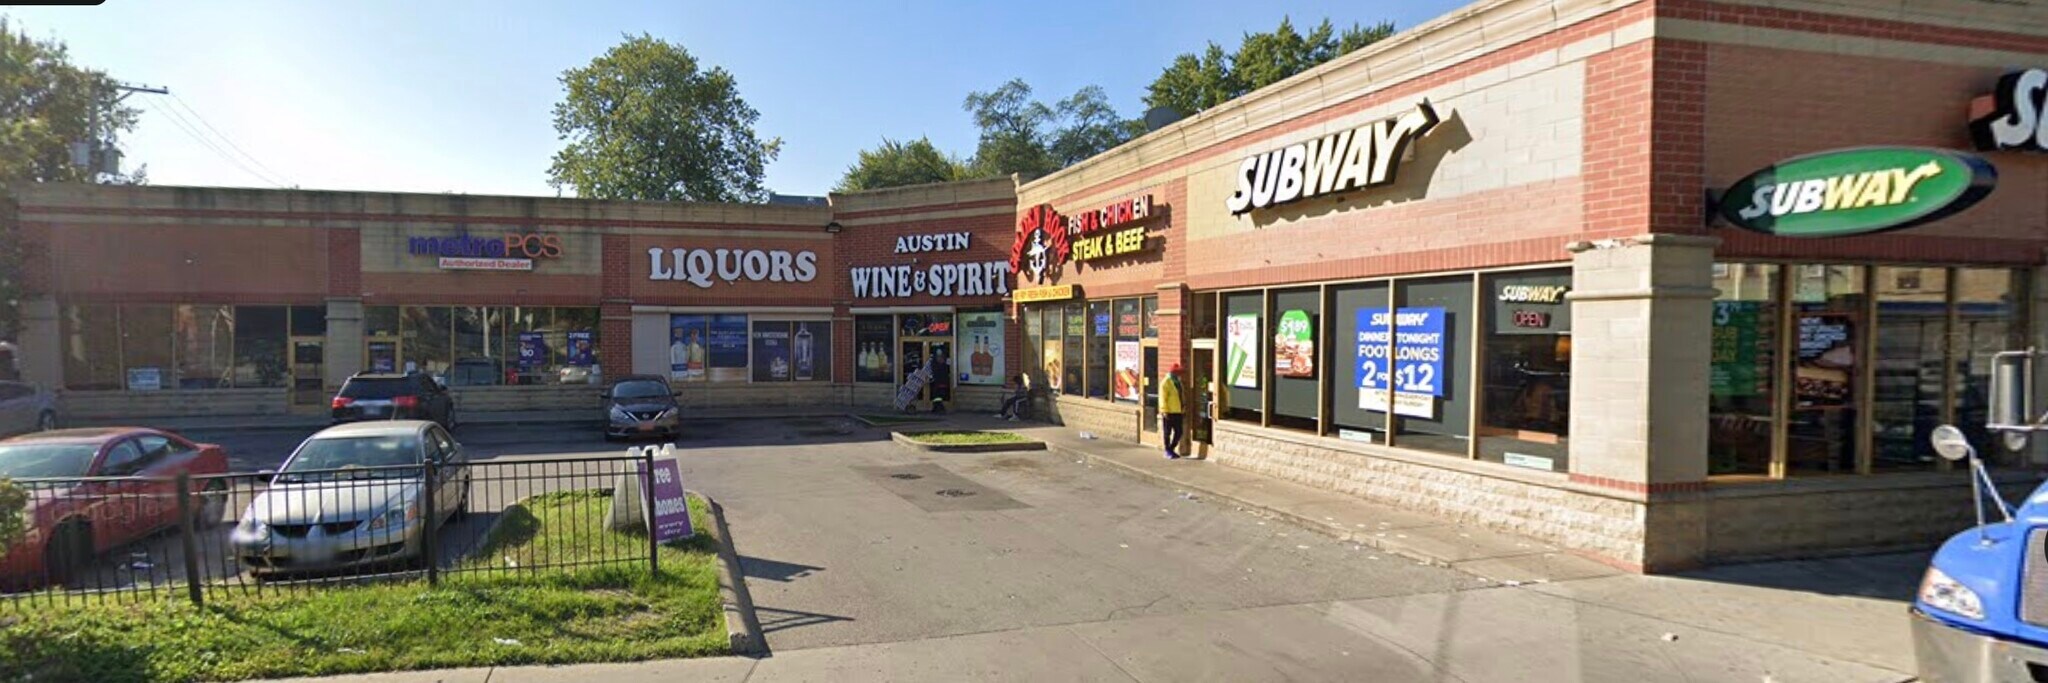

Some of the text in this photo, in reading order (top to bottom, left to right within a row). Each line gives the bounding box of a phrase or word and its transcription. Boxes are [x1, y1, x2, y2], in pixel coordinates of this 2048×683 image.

[1226, 104, 1434, 215] SUBWAY
[1739, 160, 1942, 221] SUBWAY
[1068, 195, 1149, 235] FISH & CHICKEN
[408, 232, 562, 258] metroPCS
[894, 232, 971, 254] AUSTIN
[1072, 227, 1145, 262] STEAK & BEEF
[441, 259, 530, 268] Authorized Dealer
[648, 247, 818, 288] LIQUORS
[851, 261, 1010, 298] WINE & SPIRIT
[1499, 285, 1565, 302] SUBWAY
[927, 321, 951, 333] OPEN
[1513, 310, 1545, 326] OPEN
[1396, 332, 1440, 345] TONIGHT
[1362, 360, 1376, 387] 2
[1396, 363, 1434, 392] $12
[654, 467, 671, 483] ree
[654, 497, 685, 516] hones
